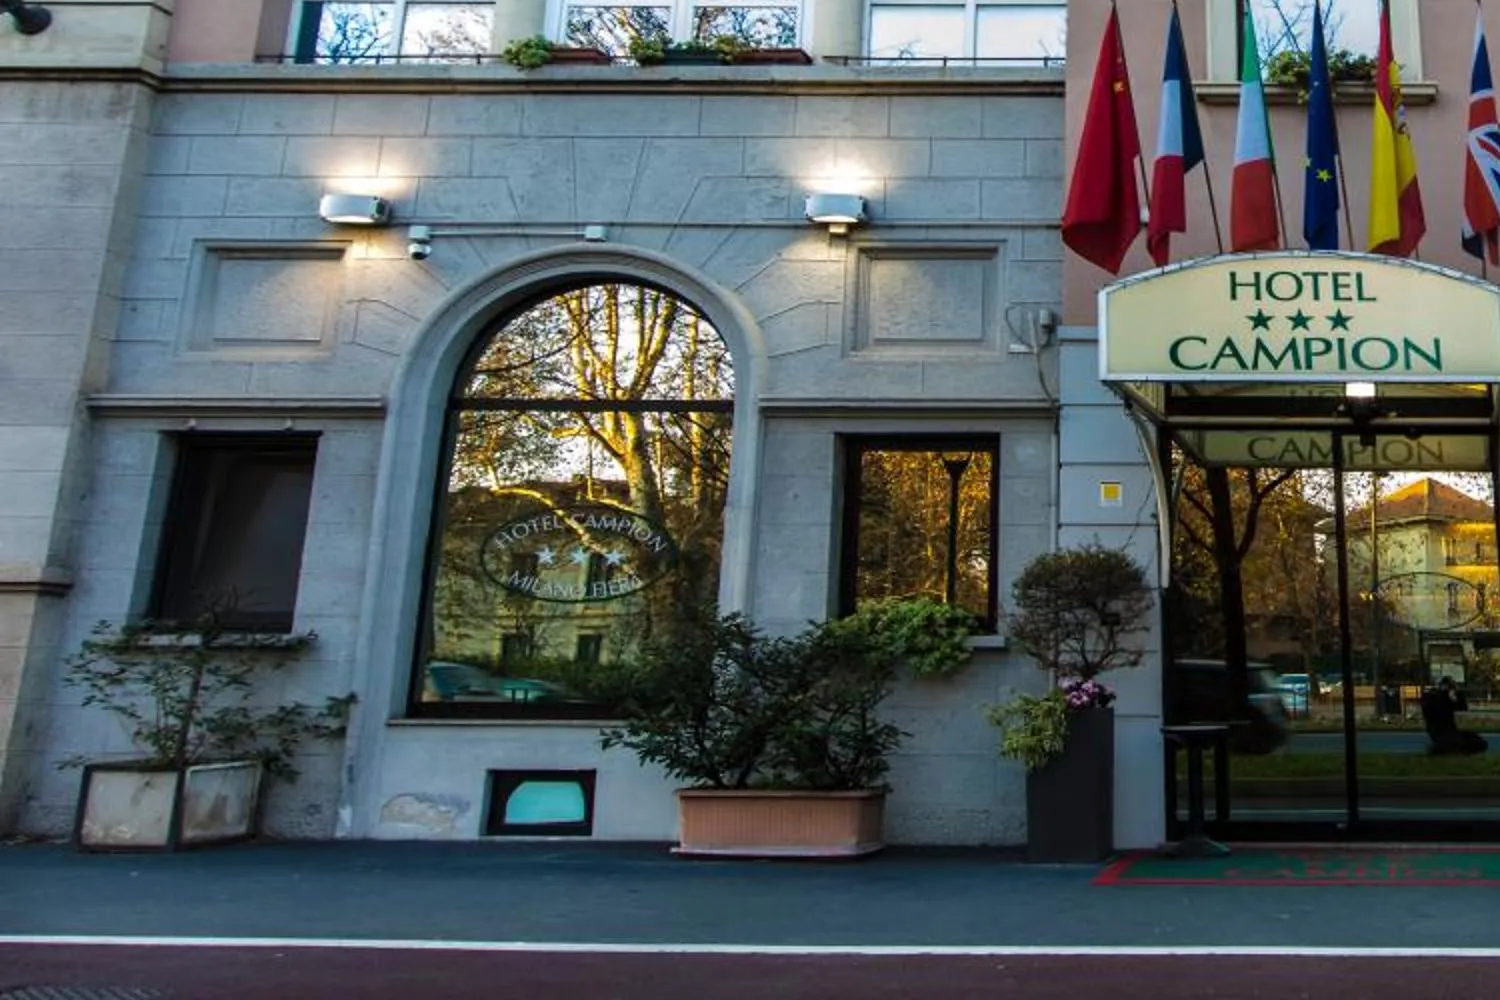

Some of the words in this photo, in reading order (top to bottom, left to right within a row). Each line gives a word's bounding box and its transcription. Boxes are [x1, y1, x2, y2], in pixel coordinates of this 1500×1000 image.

[1229, 271, 1377, 302] HOTEL
[1168, 336, 1443, 372] CAMPION
[1248, 436, 1444, 466] CAMPION
[495, 514, 564, 549] HOTEL
[571, 513, 667, 553] CAMPION
[508, 569, 586, 598] MILANO
[593, 574, 642, 598] FIERA
